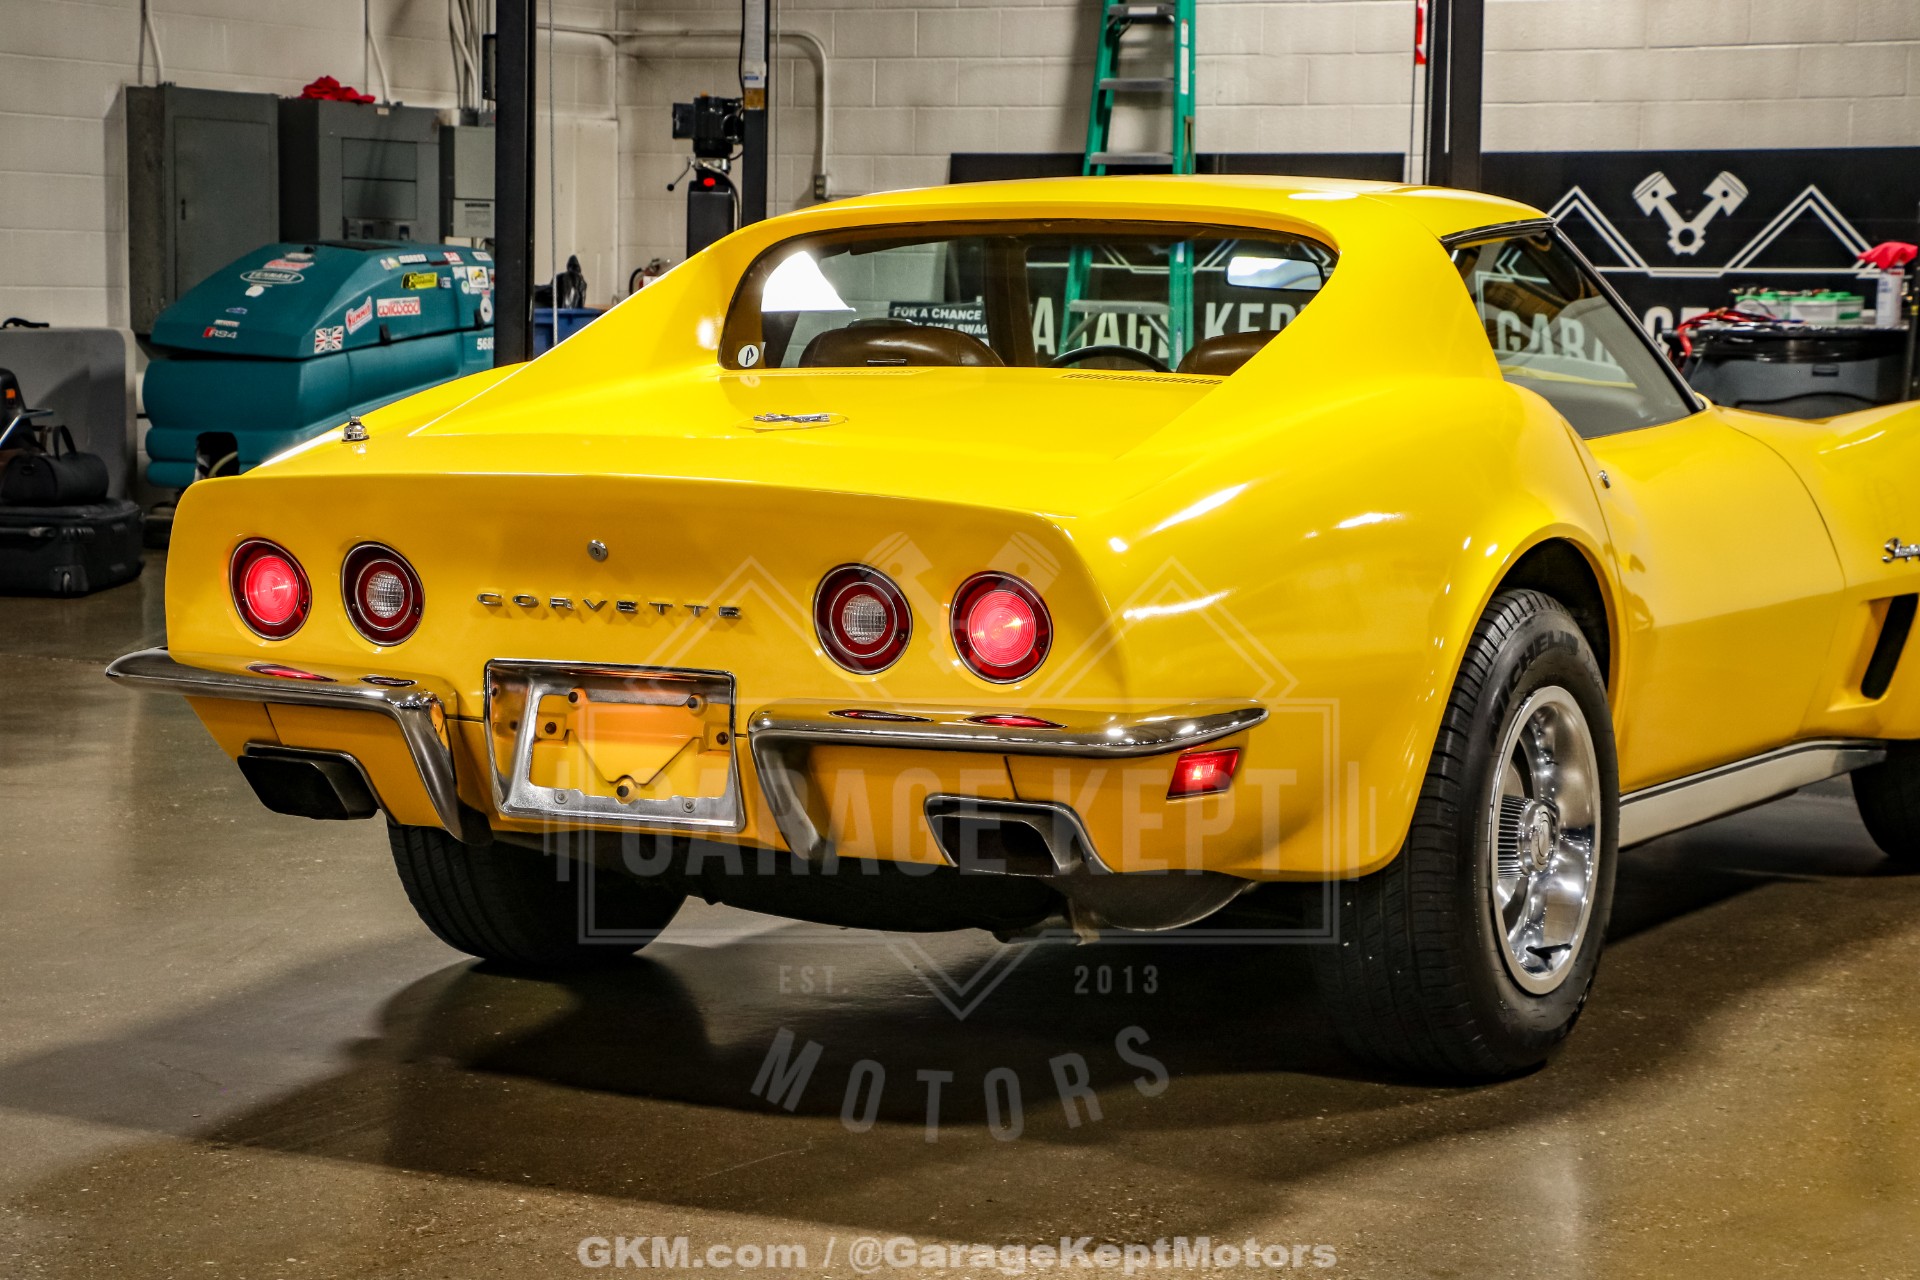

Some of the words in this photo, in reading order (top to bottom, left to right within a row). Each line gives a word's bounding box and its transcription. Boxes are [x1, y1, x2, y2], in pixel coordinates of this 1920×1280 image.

[893, 306, 917, 318] FOR
[920, 308, 929, 318] A
[931, 308, 982, 321] CHANCE
[477, 592, 742, 619] CORVETTE
